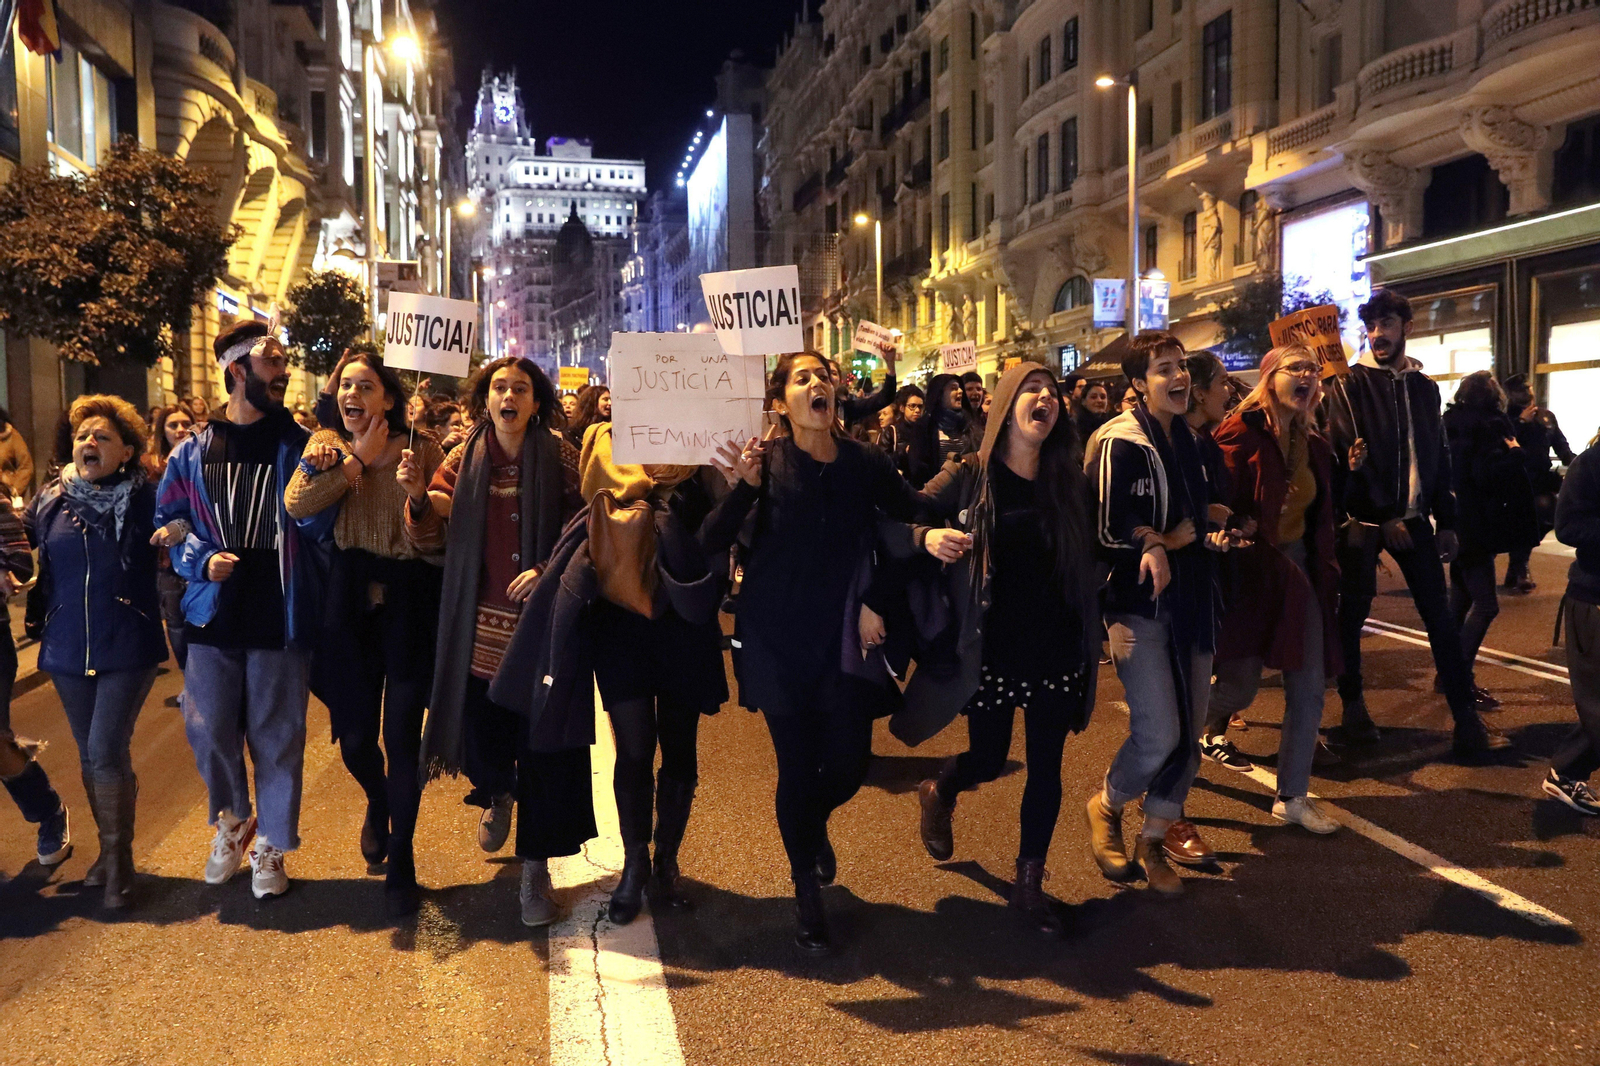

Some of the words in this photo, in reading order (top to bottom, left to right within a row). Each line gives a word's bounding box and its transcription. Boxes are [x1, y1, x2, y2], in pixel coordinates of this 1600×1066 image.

[708, 287, 799, 330] JUSTICIA!
[387, 311, 472, 355] JUSTICIA!
[655, 354, 678, 364] POR
[701, 354, 728, 364] UNA
